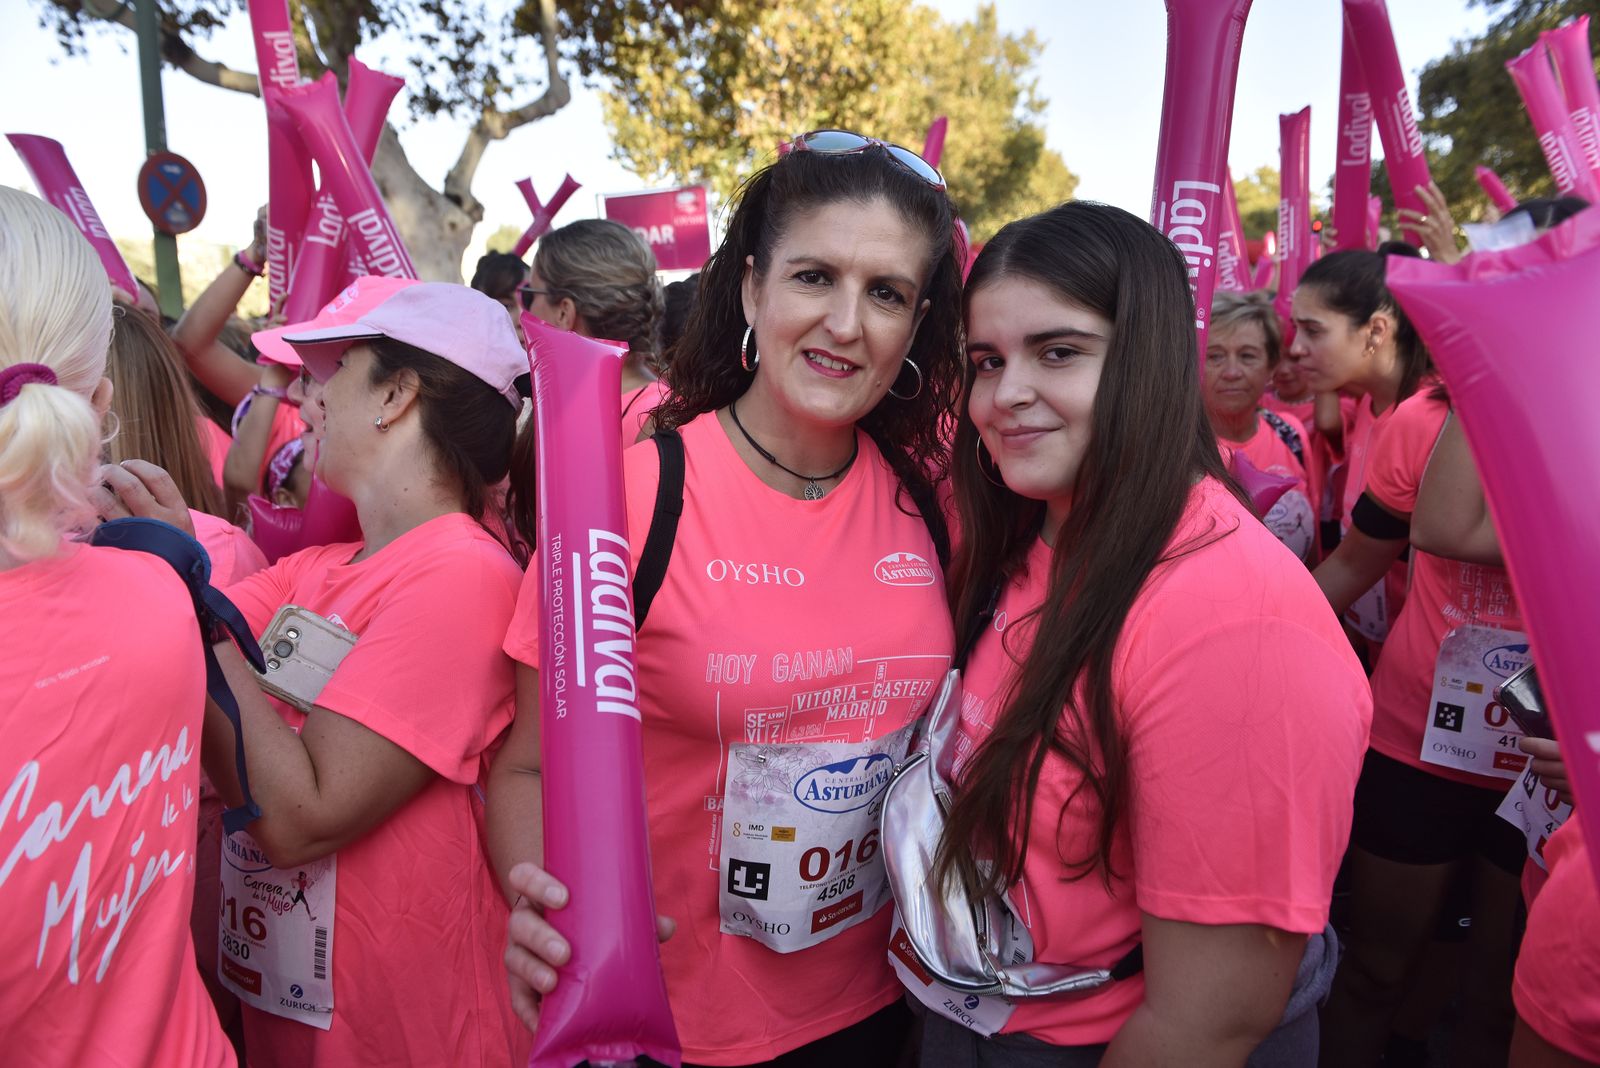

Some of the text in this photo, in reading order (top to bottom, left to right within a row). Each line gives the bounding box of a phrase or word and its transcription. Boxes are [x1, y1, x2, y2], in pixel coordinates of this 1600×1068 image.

[1342, 92, 1370, 166] Ladival
[706, 559, 805, 587] OYSHO
[551, 533, 567, 720] TRIPLE PROTECCIÓN SOLAR
[589, 528, 643, 723] Ladival
[706, 646, 853, 684] HOY GANAN
[796, 686, 857, 710] VITORIA
[872, 680, 931, 698] GASTEIZ
[747, 712, 767, 729] SE
[825, 700, 887, 722] MADRID
[1432, 742, 1477, 760] OYSHO
[803, 768, 889, 802] ASTURIANA
[825, 775, 862, 784] CENTRAL
[0, 726, 195, 888] Carrera
[799, 828, 879, 883] 016
[243, 874, 283, 896] Carrera
[817, 874, 856, 902] 4508
[37, 842, 186, 985] Mujer
[732, 912, 791, 936] OYSHO
[279, 998, 316, 1012] ZURICH
[943, 999, 975, 1028] ZURICH
